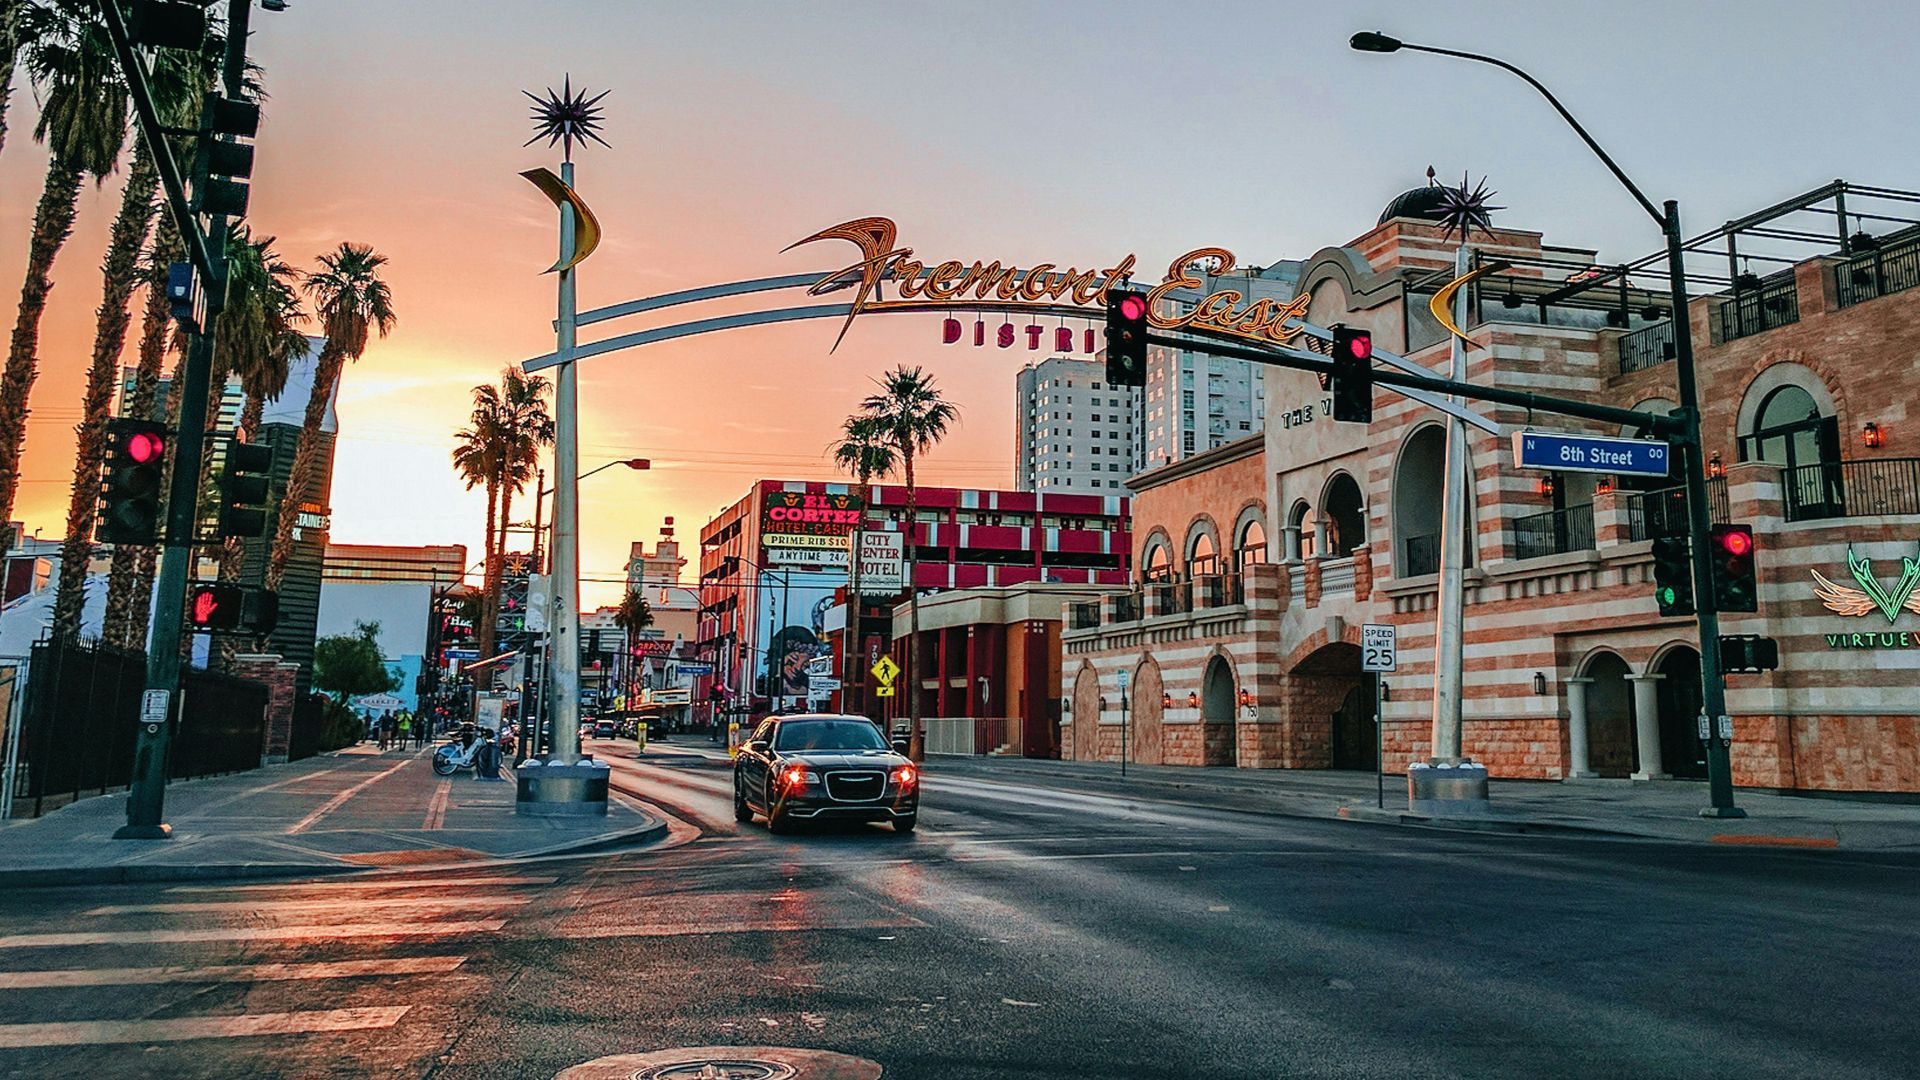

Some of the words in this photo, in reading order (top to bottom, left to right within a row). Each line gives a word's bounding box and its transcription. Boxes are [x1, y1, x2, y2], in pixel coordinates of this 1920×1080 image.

[779, 216, 1136, 355] Fremont
[1146, 247, 1312, 340] East
[943, 318, 1106, 354] DISTRI
[1281, 405, 1313, 430] THE
[1526, 439, 1536, 451] N
[1560, 445, 1586, 462] 8th
[1590, 447, 1634, 466] Street
[803, 495, 832, 509] EL
[768, 506, 861, 524] CORTEZ
[765, 520, 808, 533] HOTEL
[813, 522, 854, 536] CASIN
[770, 535, 805, 546] PRIME
[807, 537, 827, 547] RIB
[865, 534, 891, 546] CITY
[779, 550, 821, 562] ANYTIME
[862, 547, 900, 560] ENTER
[1365, 629, 1393, 638] SPEED
[1826, 632, 1910, 648] VIRTUE
[1367, 639, 1391, 647] LIMIT
[1366, 648, 1393, 667] 25
